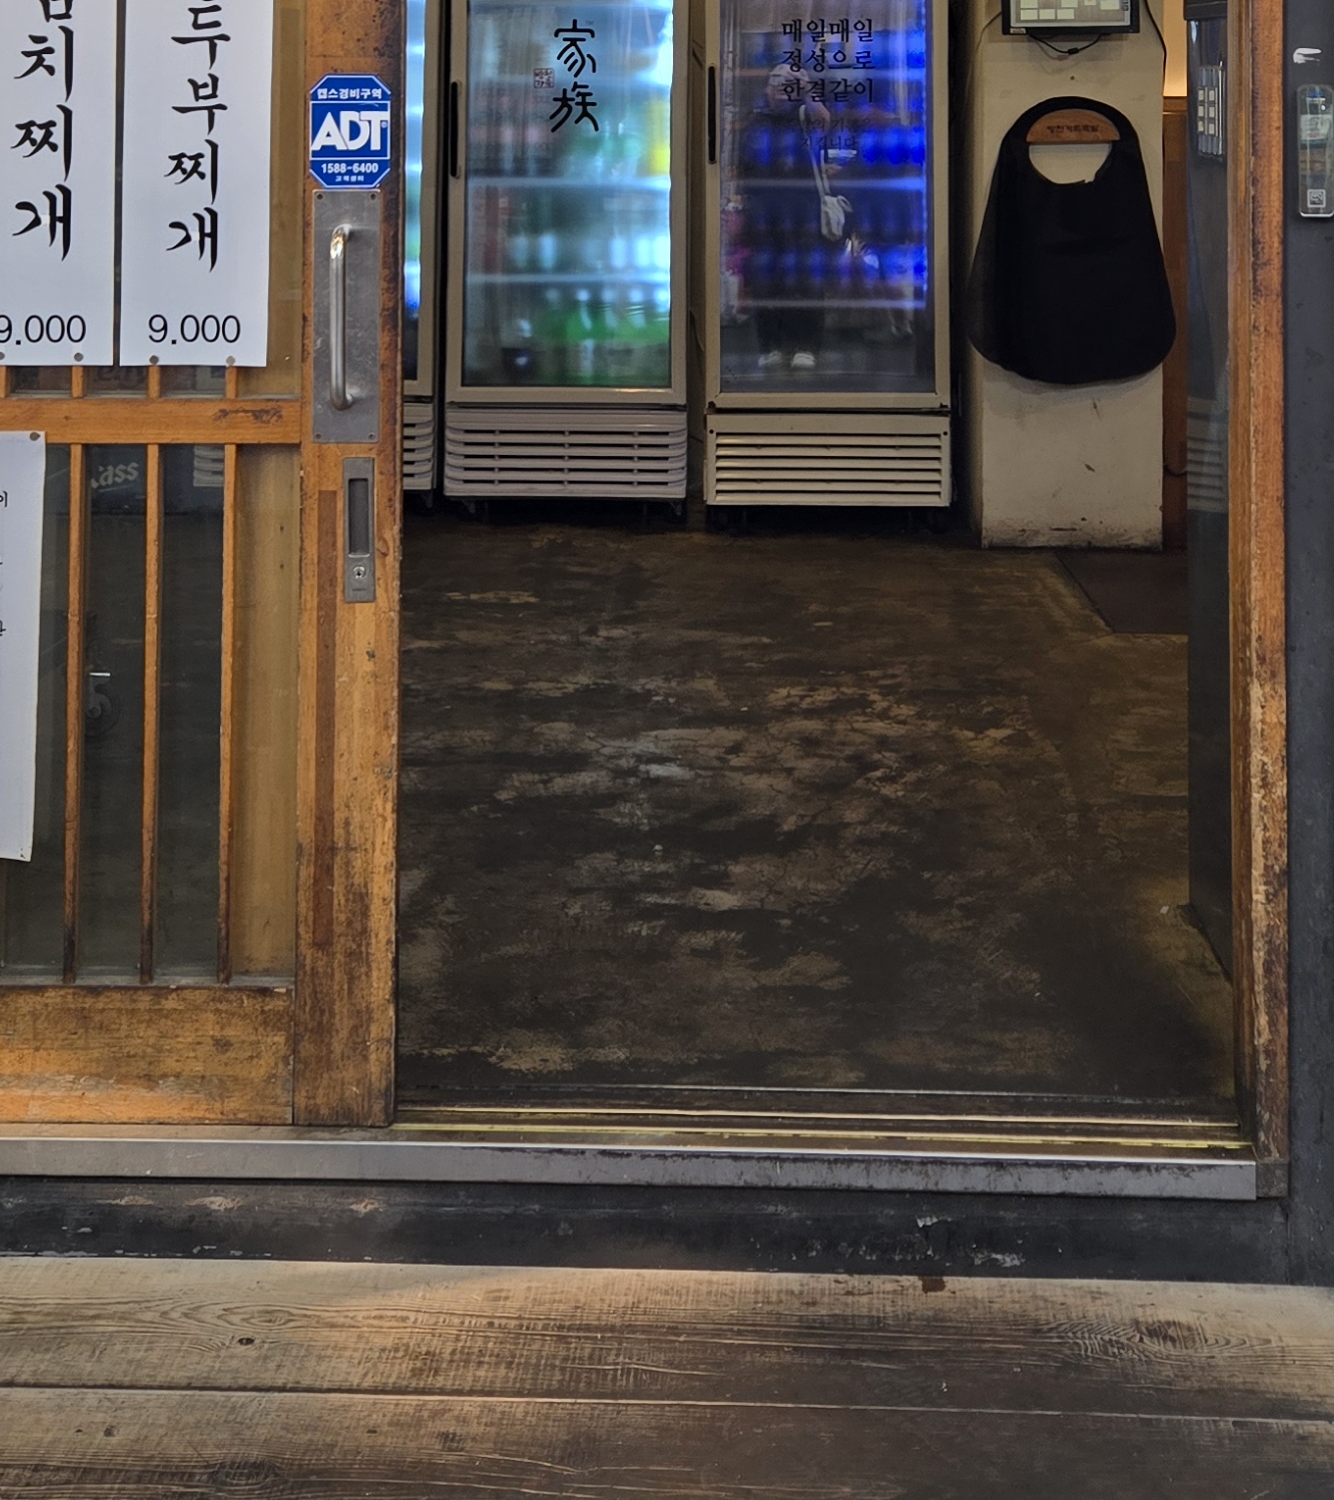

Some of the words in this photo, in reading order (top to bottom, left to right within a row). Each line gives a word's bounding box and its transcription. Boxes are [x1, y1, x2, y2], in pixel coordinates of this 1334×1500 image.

[781, 18, 874, 43] 매일매일
[781, 48, 876, 73] 정성으로
[781, 78, 873, 103] 한결같이
[311, 111, 388, 151] ADT
[321, 162, 379, 174] 1588-6400
